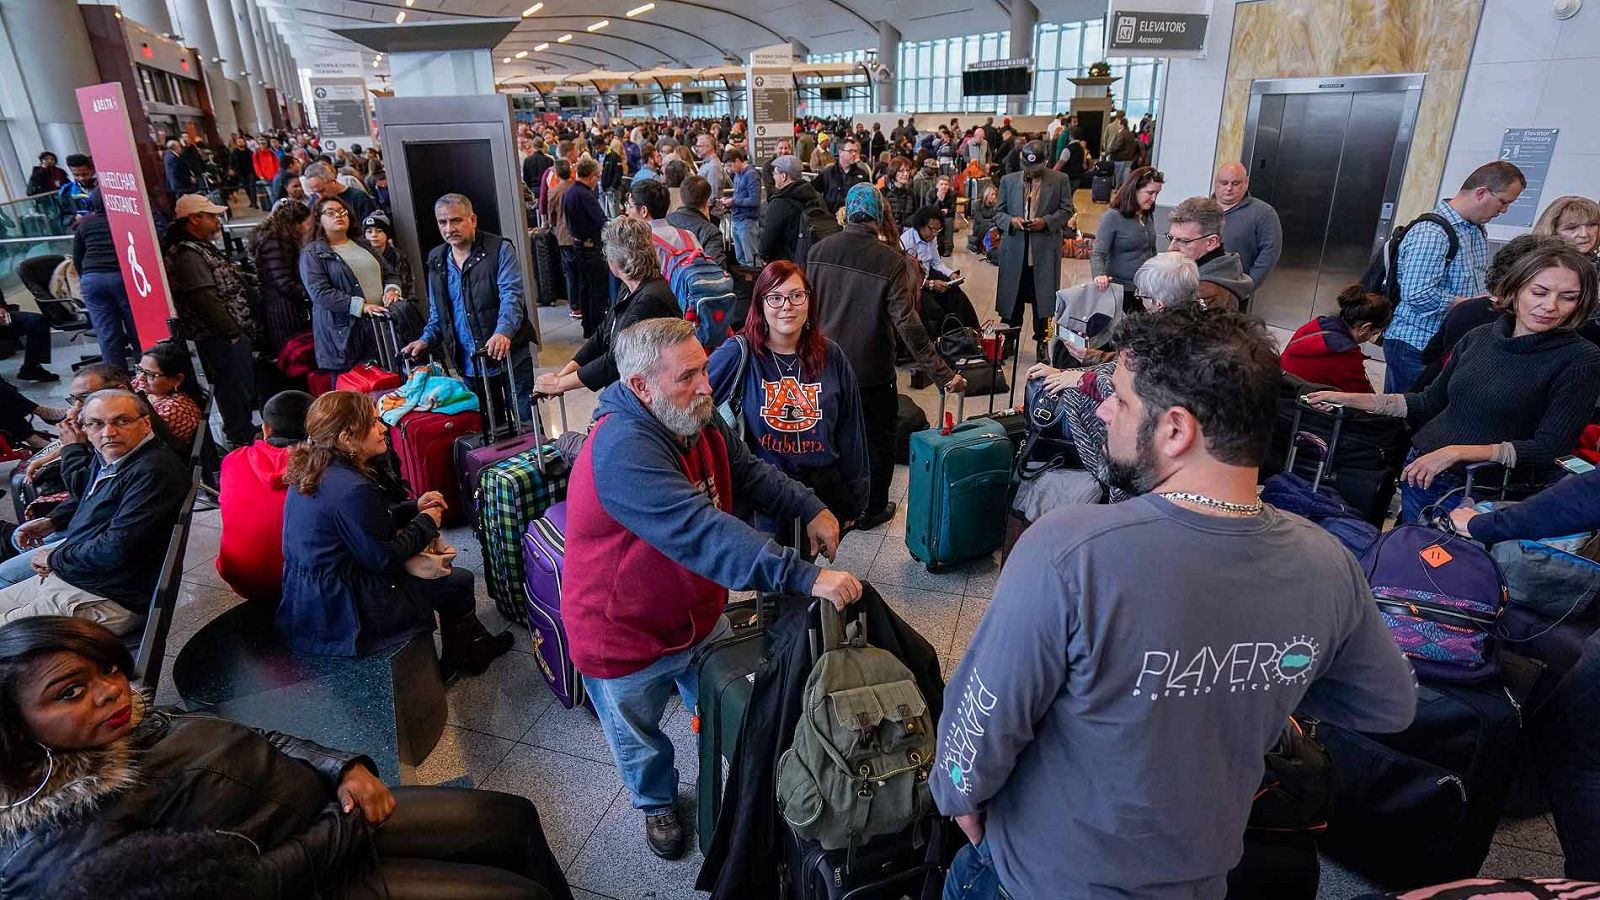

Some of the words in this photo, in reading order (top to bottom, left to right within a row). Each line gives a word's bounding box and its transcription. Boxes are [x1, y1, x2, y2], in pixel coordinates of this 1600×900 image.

[1140, 21, 1186, 33] ELEVATORS
[1138, 36, 1163, 44] Ascensor
[991, 57, 1029, 67] INFORMATION
[97, 98, 114, 112] DELTA
[1501, 148, 1511, 160] 2
[97, 171, 137, 191] WHEELCHAIR
[105, 193, 140, 215] ASSISTANCE
[759, 433, 823, 454] Auburn
[1136, 638, 1318, 689] PLAYERO
[1133, 687, 1212, 701] PUERTO
[1230, 683, 1272, 693] RICO
